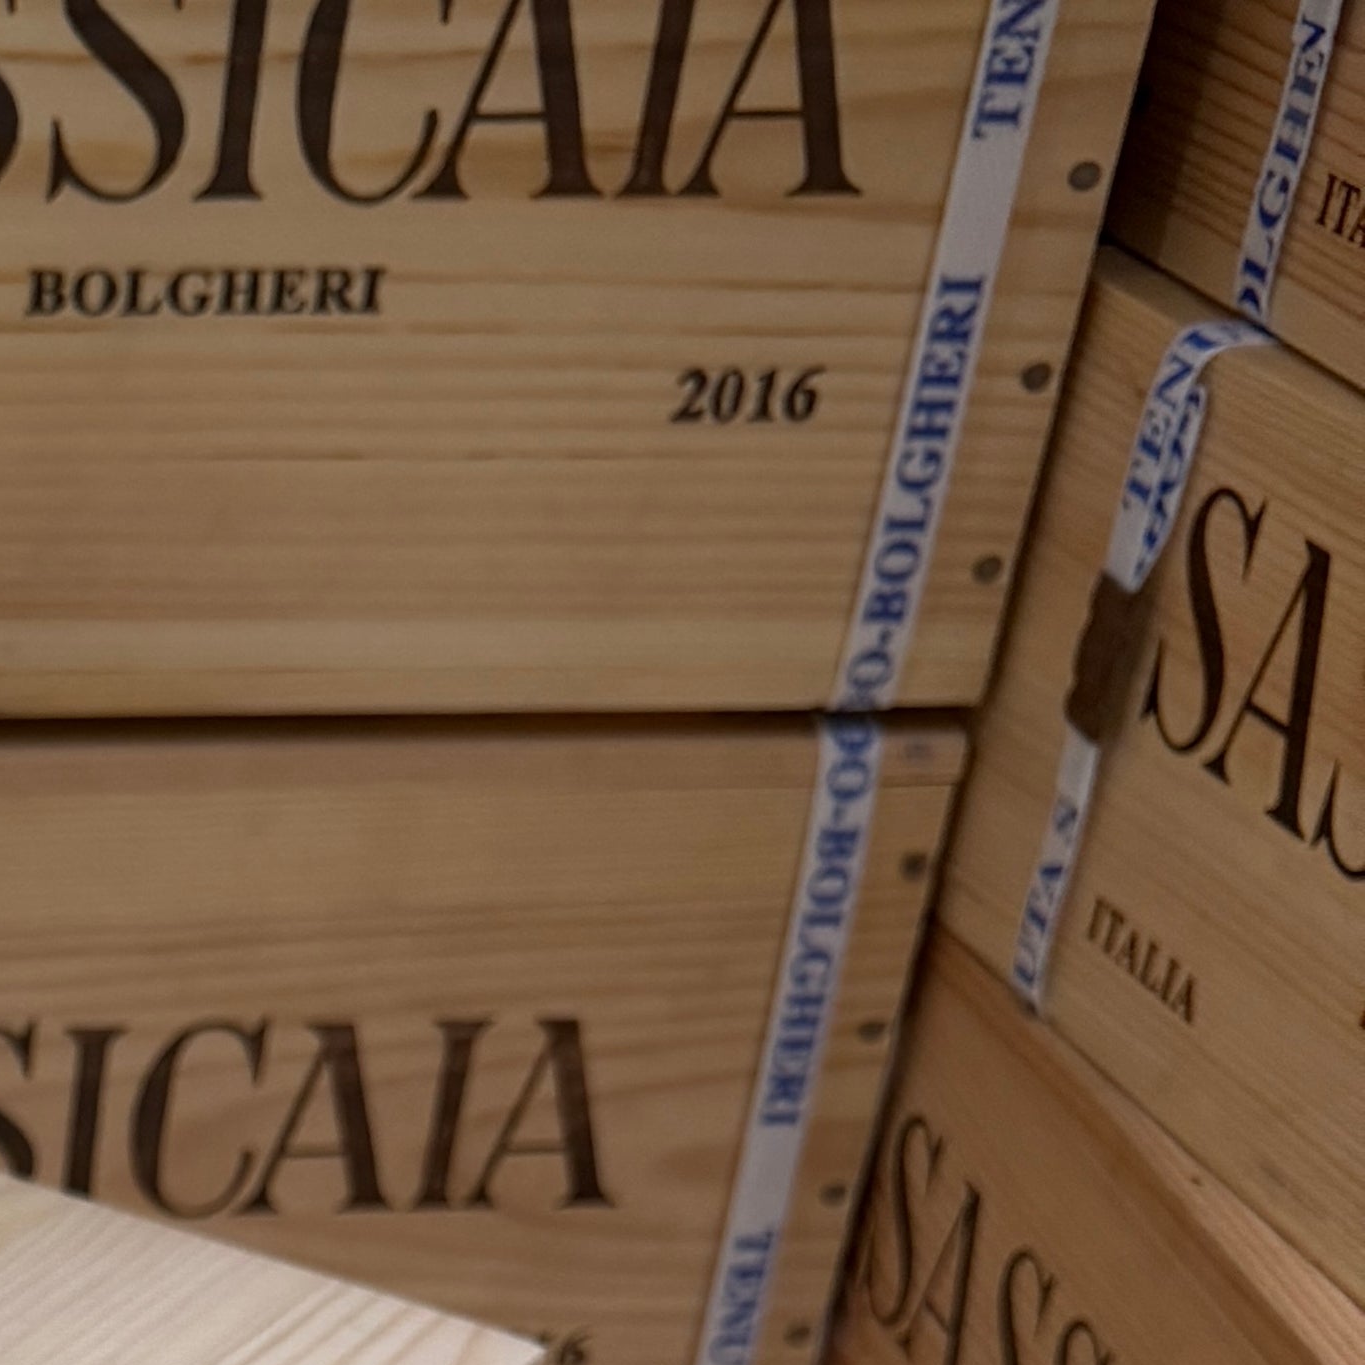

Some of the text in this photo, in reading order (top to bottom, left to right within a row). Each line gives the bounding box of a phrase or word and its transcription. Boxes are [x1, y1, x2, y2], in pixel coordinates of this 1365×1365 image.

[25, 266, 387, 320] BOLGHERI
[671, 366, 828, 426] 2016
[1086, 898, 1198, 1024] ITALIA
